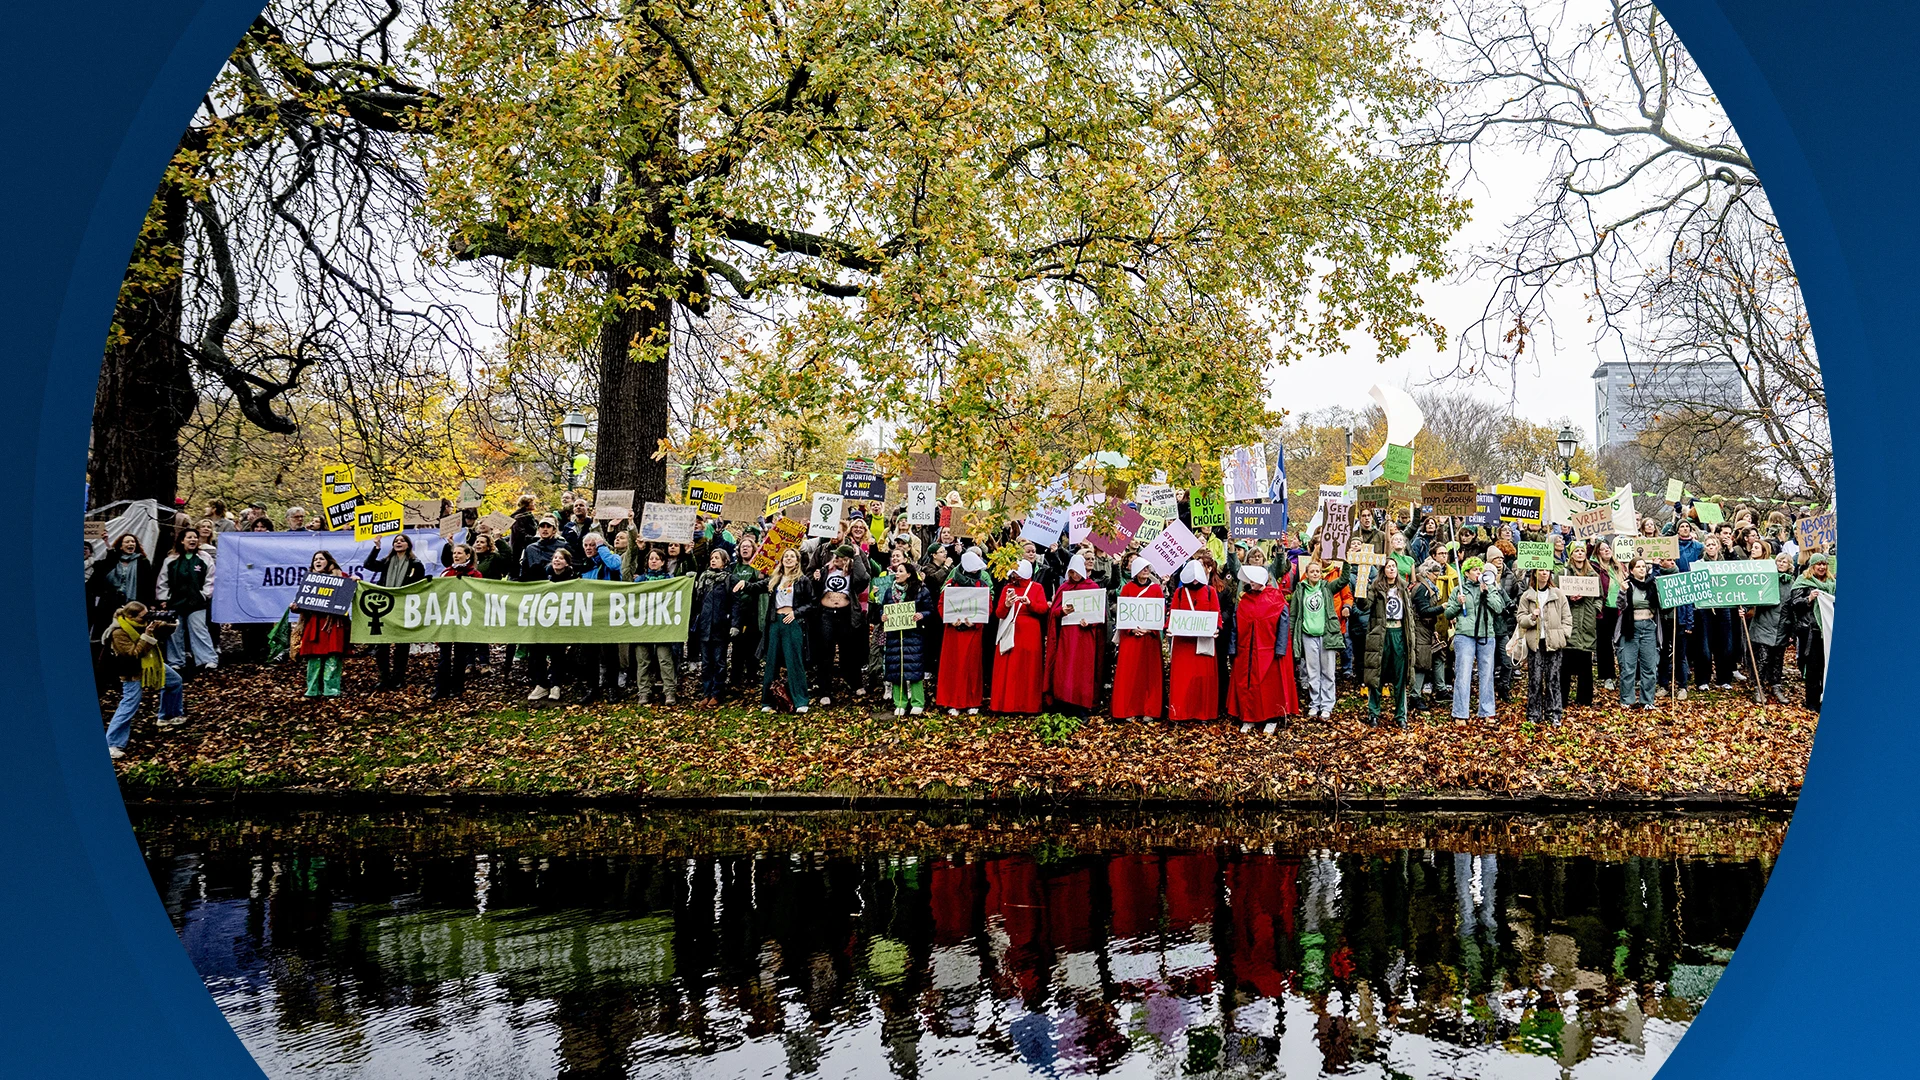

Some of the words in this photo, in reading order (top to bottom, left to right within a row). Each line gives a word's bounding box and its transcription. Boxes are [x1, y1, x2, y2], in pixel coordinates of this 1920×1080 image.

[326, 475, 334, 483] MY
[846, 474, 876, 482] ABORTION
[334, 484, 351, 492] RIGHTS
[1446, 484, 1474, 492] KEUZE
[692, 490, 702, 498] MY
[704, 492, 723, 500] BODY
[770, 496, 780, 506] MY
[781, 491, 796, 500] BODY
[780, 495, 802, 508] RIGHTS
[1476, 494, 1494, 502] ORTION
[1501, 496, 1512, 504] MY
[1513, 497, 1533, 506] BODY
[329, 505, 339, 515] MY
[340, 499, 357, 511] BODY
[701, 502, 722, 512] RIGHT
[1203, 506, 1214, 514] MY
[1234, 506, 1270, 514] ABORTION
[1330, 503, 1348, 513] GET
[1436, 504, 1470, 515] RECHT
[1501, 506, 1511, 515] MY
[1512, 508, 1539, 518] CHOICE
[332, 516, 342, 526] MY
[343, 511, 356, 522] CHO
[360, 514, 372, 524] MY
[374, 511, 393, 521] BODY
[1193, 514, 1224, 526] CHOICE!
[1244, 516, 1258, 525] NOT
[1329, 514, 1346, 522] THE
[1576, 510, 1606, 526] VRIJE
[1800, 514, 1832, 534] ABORT
[360, 526, 371, 535] MY
[373, 520, 399, 533] RIGHTS
[1028, 520, 1058, 534] STRAFRECHT
[1234, 528, 1258, 536] CRIME
[1326, 524, 1350, 532] FUCK
[1579, 520, 1614, 538] KEUZE
[1324, 532, 1348, 544] OUT
[1804, 534, 1814, 548] IS
[1818, 530, 1834, 544] ZO
[1162, 541, 1171, 550] OF
[1169, 548, 1179, 558] MY
[1164, 532, 1178, 546] STAY
[1176, 546, 1189, 558] OUT
[1154, 544, 1176, 566] UTERUS
[262, 566, 307, 586] ABOR
[305, 574, 344, 587] ABORTION
[1662, 575, 1686, 590] JOUW
[1690, 571, 1708, 584] GOD
[1711, 576, 1728, 587] NS
[1736, 574, 1770, 586] GOED
[302, 585, 311, 593] IS
[310, 586, 317, 594] A
[317, 587, 334, 597] NOT
[1666, 589, 1672, 598] IS
[1675, 585, 1690, 596] NIET
[297, 596, 304, 604] A
[304, 597, 330, 608] CRIME
[1664, 590, 1712, 607] GYNAECOLOOG
[404, 591, 472, 628] BAAS
[484, 594, 509, 627] IN
[518, 592, 593, 627] EIGEN
[609, 591, 683, 627] BUIK!
[885, 606, 896, 616] OUR
[896, 602, 914, 614] BODIES
[948, 598, 978, 618] WIJ
[1119, 602, 1163, 622] BROED
[886, 617, 896, 628] UR
[1172, 616, 1212, 632] MACHINE
